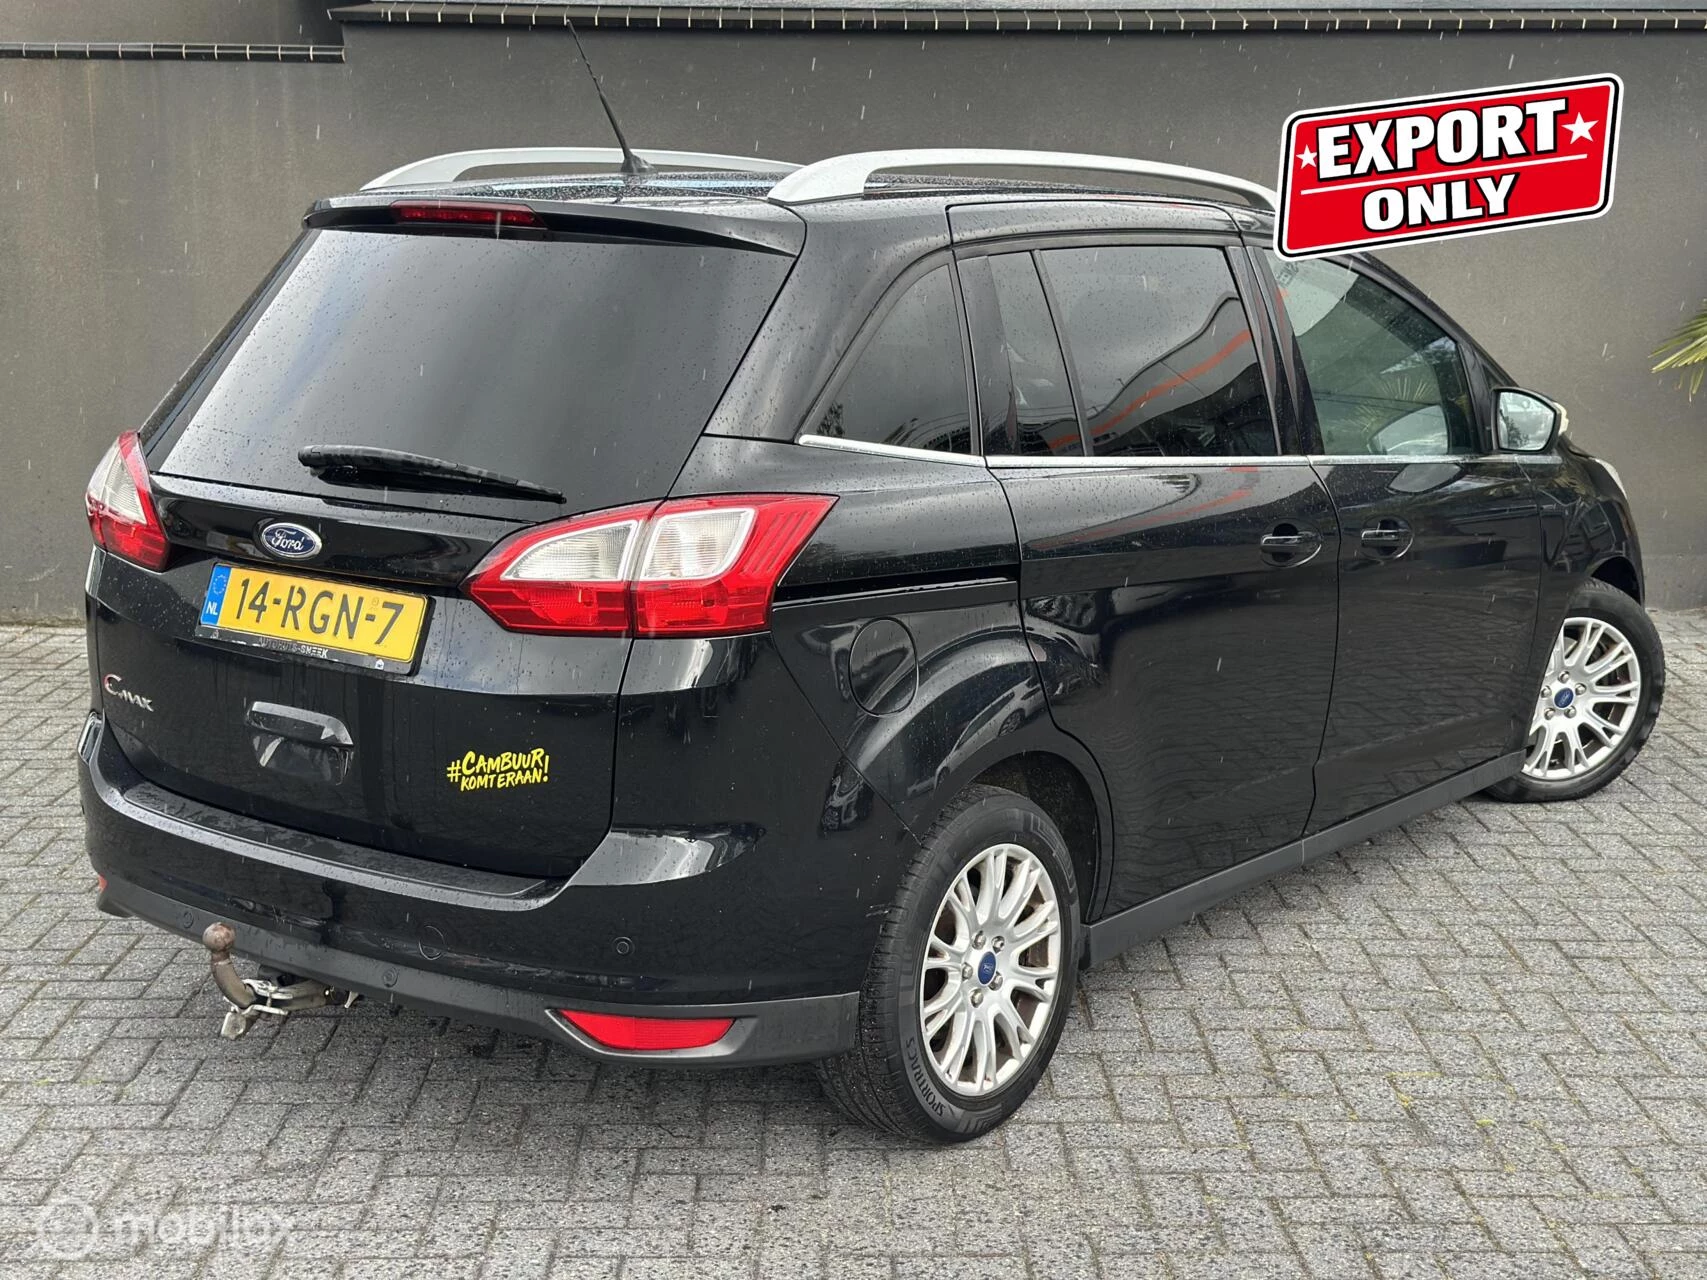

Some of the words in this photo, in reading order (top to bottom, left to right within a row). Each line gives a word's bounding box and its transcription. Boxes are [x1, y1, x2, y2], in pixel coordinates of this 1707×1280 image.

[271, 530, 305, 551] Ford
[206, 601, 218, 616] NL
[235, 578, 404, 645] 14-RGN-7
